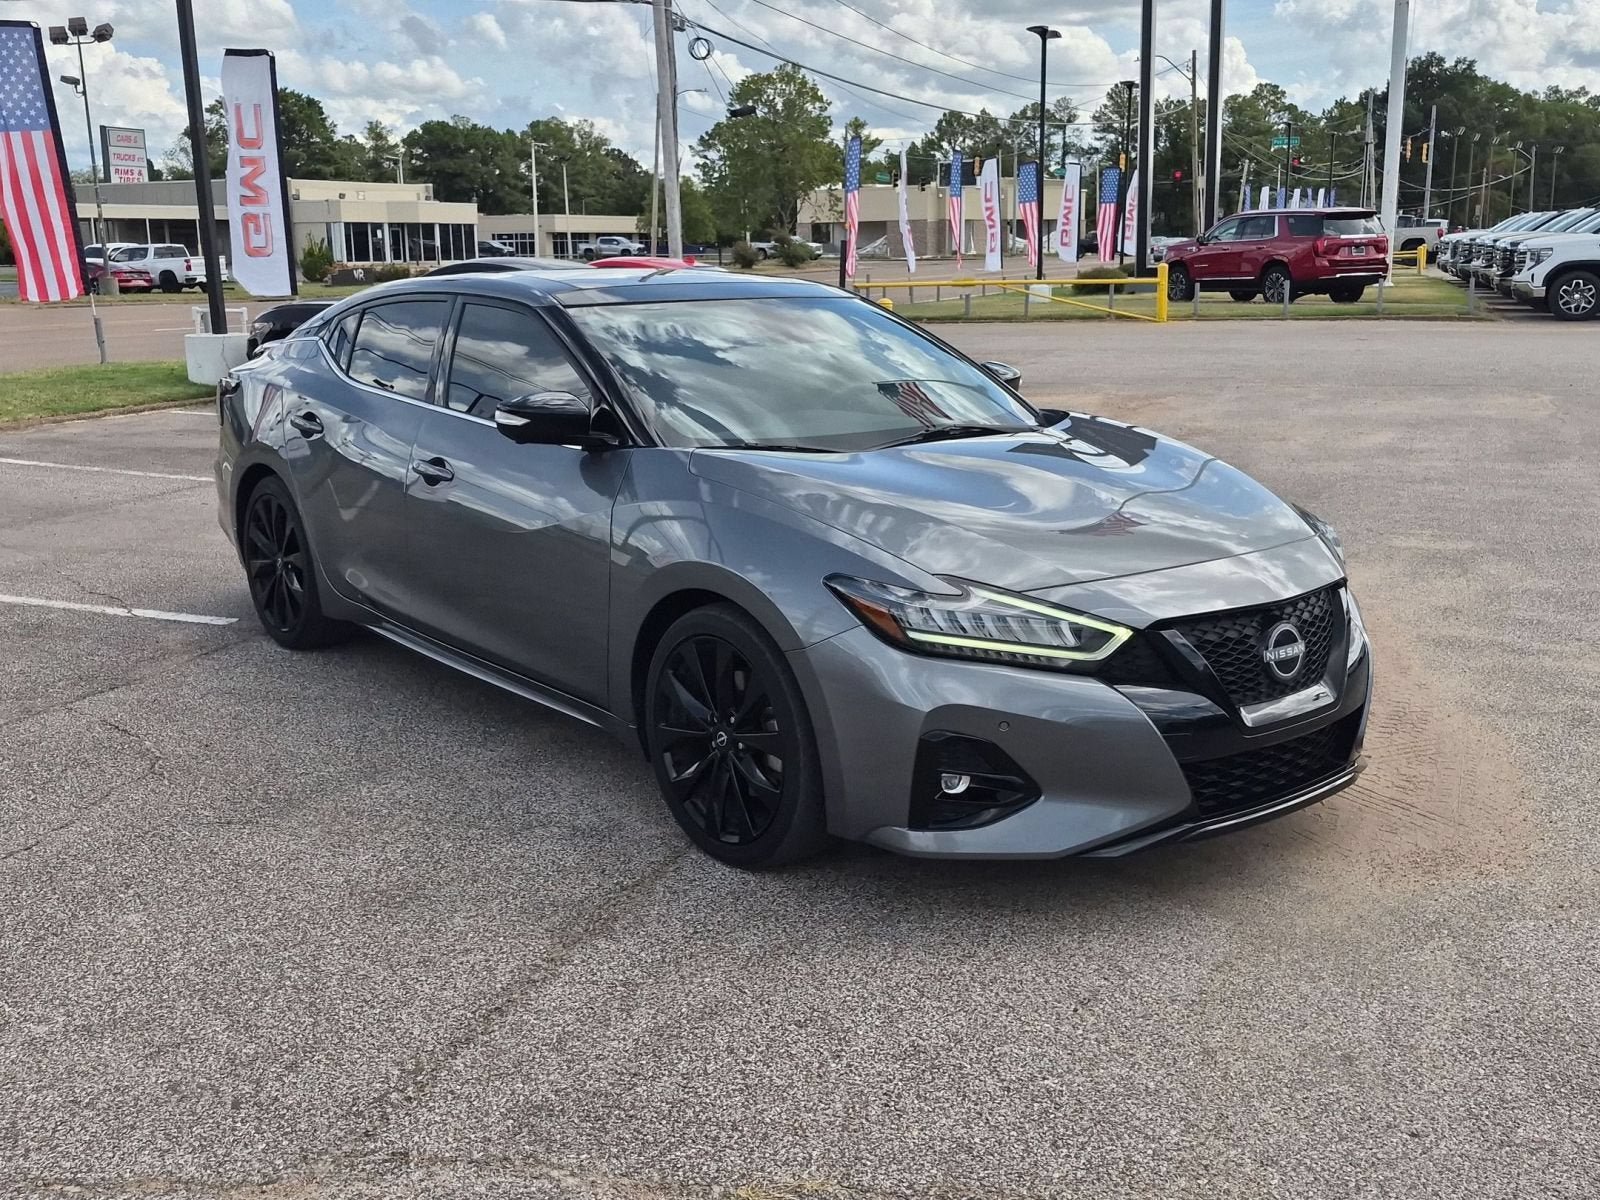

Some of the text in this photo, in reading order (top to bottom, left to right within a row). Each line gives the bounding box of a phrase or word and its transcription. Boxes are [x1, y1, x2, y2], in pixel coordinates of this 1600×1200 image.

[116, 134, 132, 144] CARS
[112, 153, 136, 162] TRUCKS
[114, 168, 135, 176] RIMS
[353, 268, 366, 281] VR
[1266, 644, 1304, 660] NISSAN
